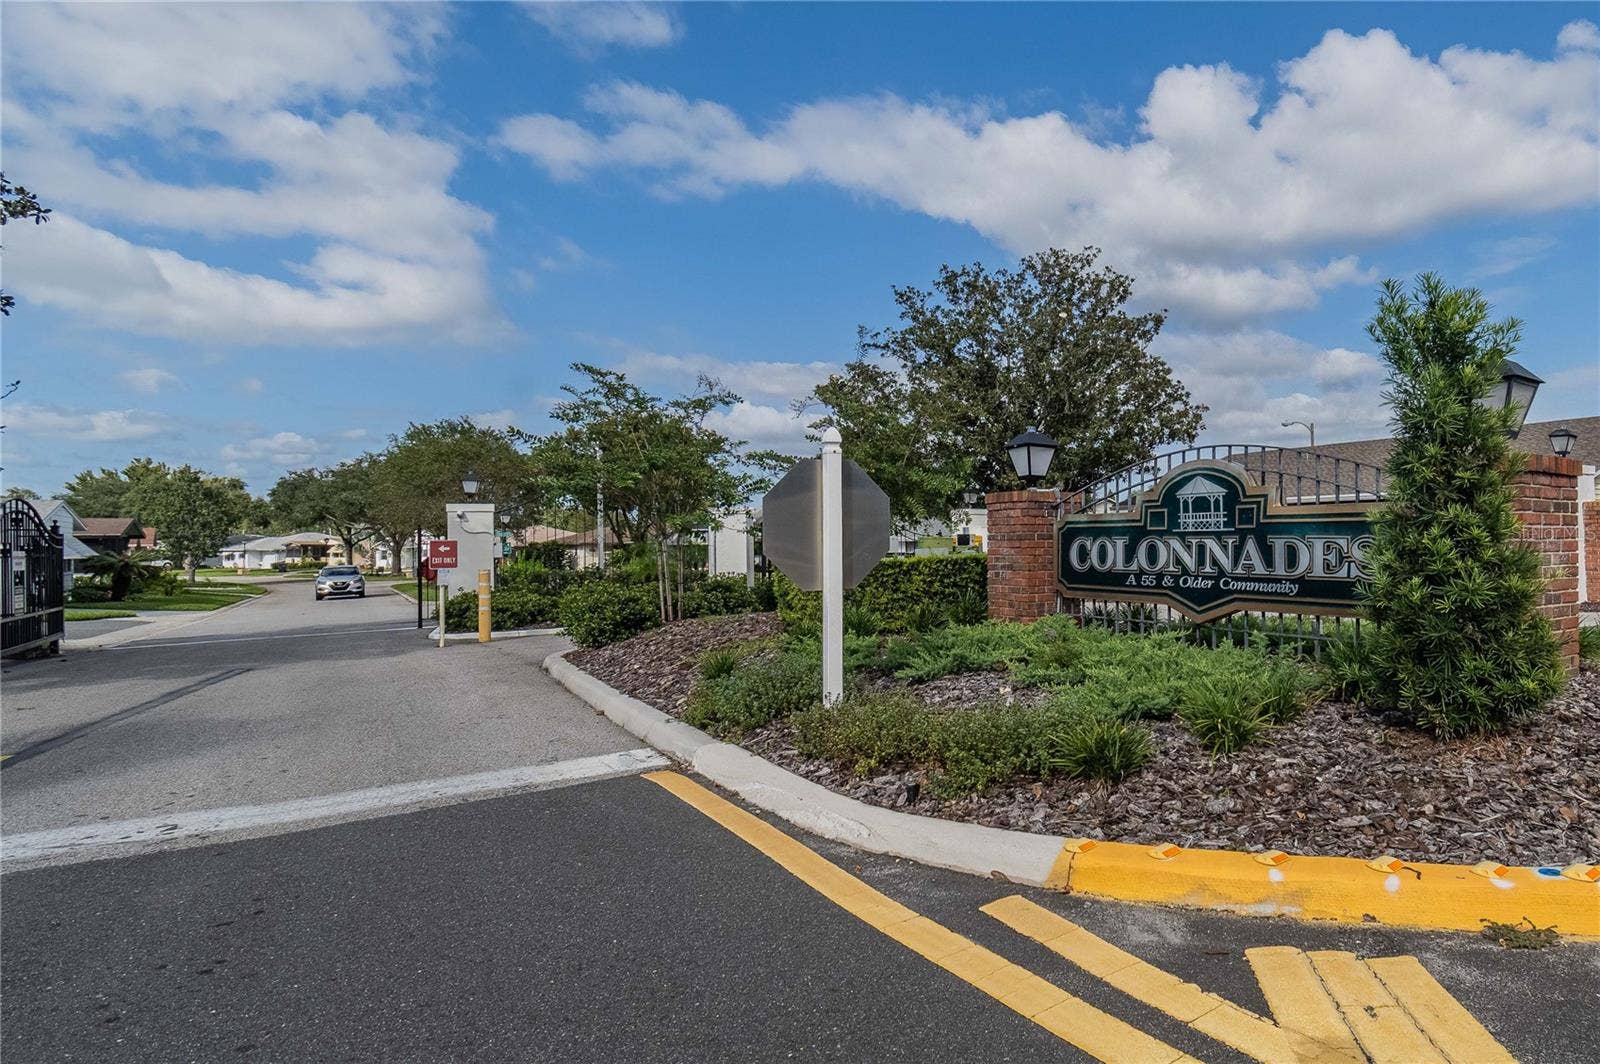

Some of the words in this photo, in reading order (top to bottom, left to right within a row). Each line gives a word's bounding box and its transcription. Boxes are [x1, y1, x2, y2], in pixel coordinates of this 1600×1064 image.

[1125, 574, 1137, 586] A
[1140, 575, 1156, 587] 55
[1161, 574, 1175, 587] &
[1179, 575, 1215, 589] Older
[1219, 577, 1299, 595] Community
